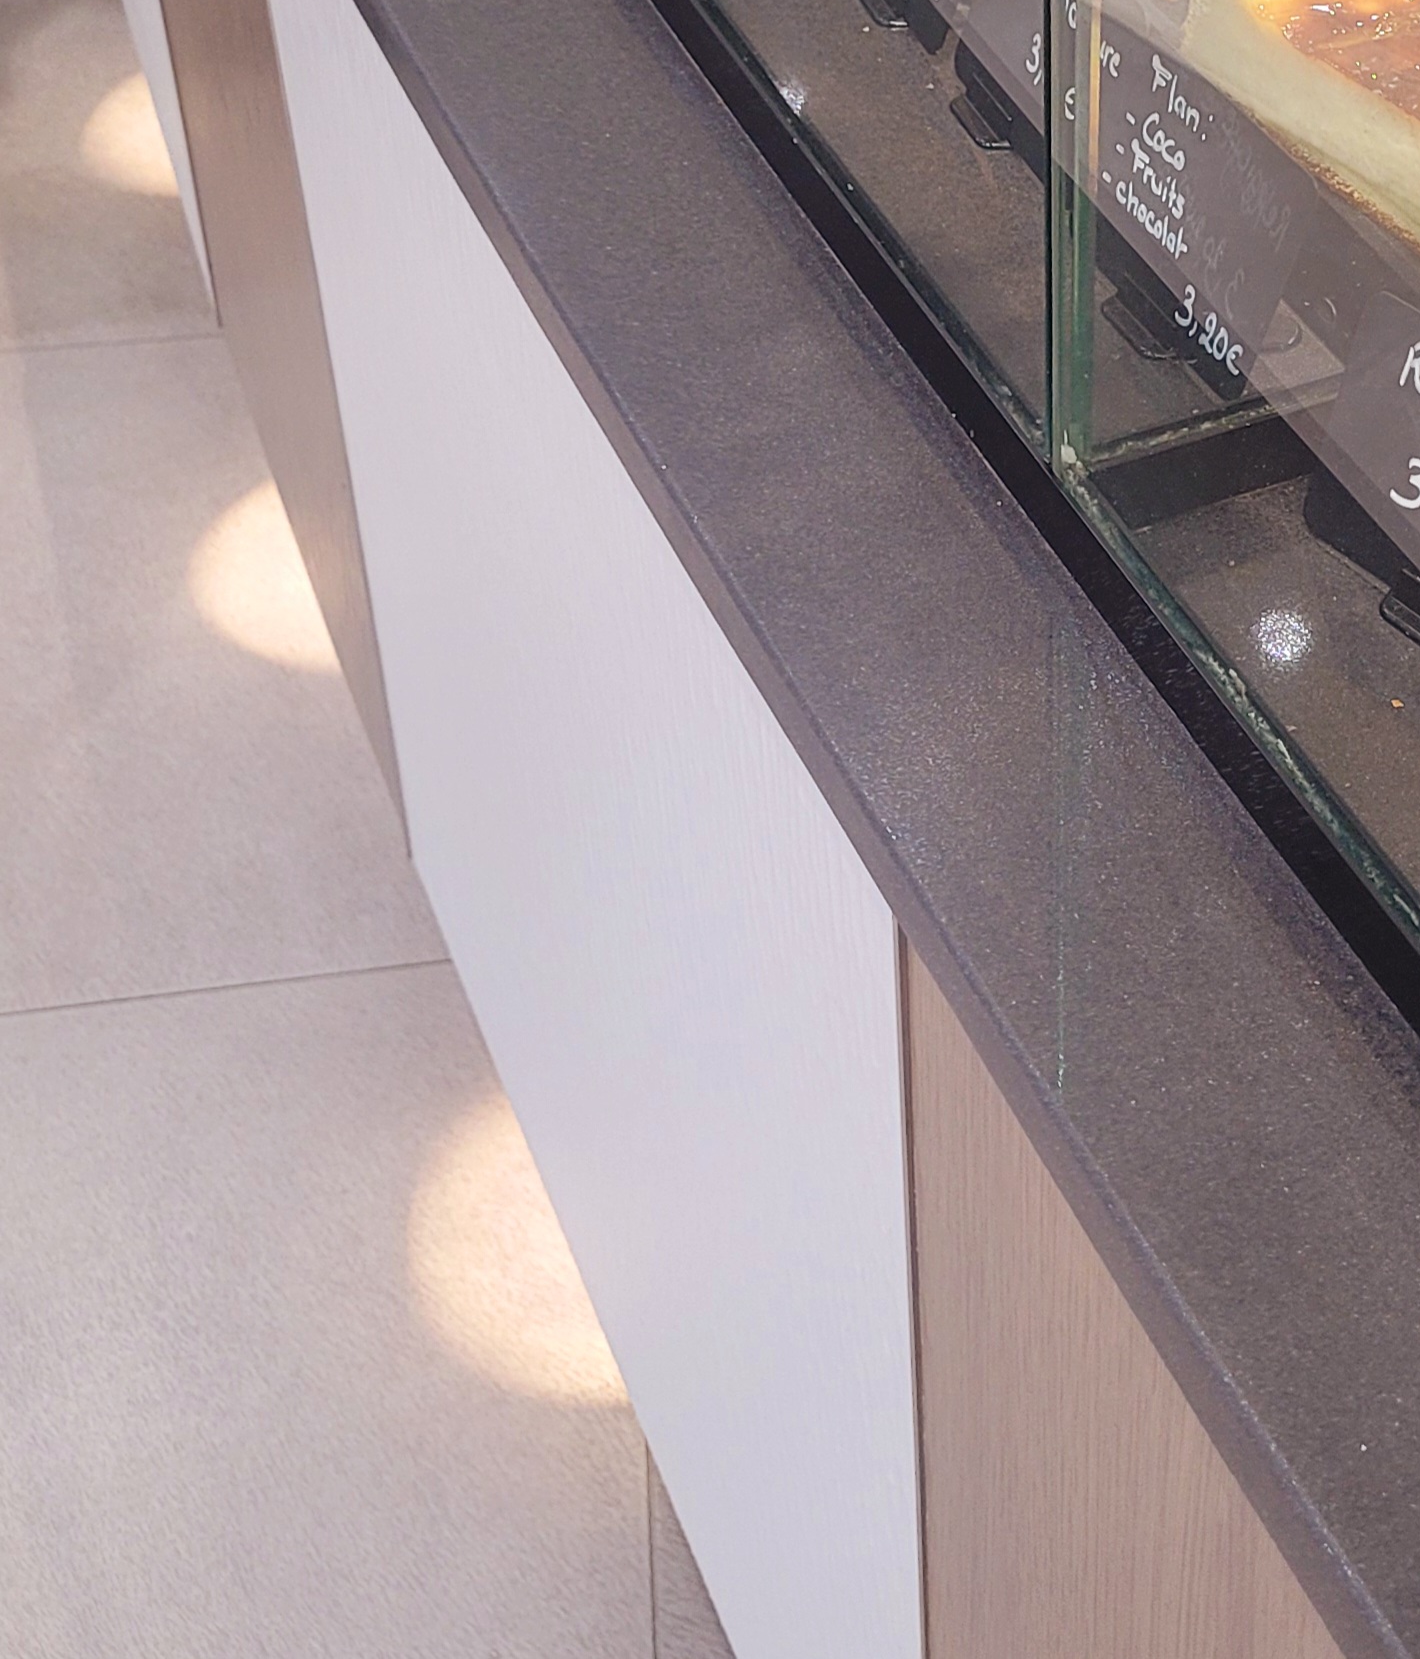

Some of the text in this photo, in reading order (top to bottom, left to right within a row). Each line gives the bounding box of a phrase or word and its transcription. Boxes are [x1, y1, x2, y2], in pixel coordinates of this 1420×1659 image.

[1131, 138, 1185, 220] Fruits
[1142, 111, 1186, 172] Coco
[1115, 180, 1188, 260] chocolat
